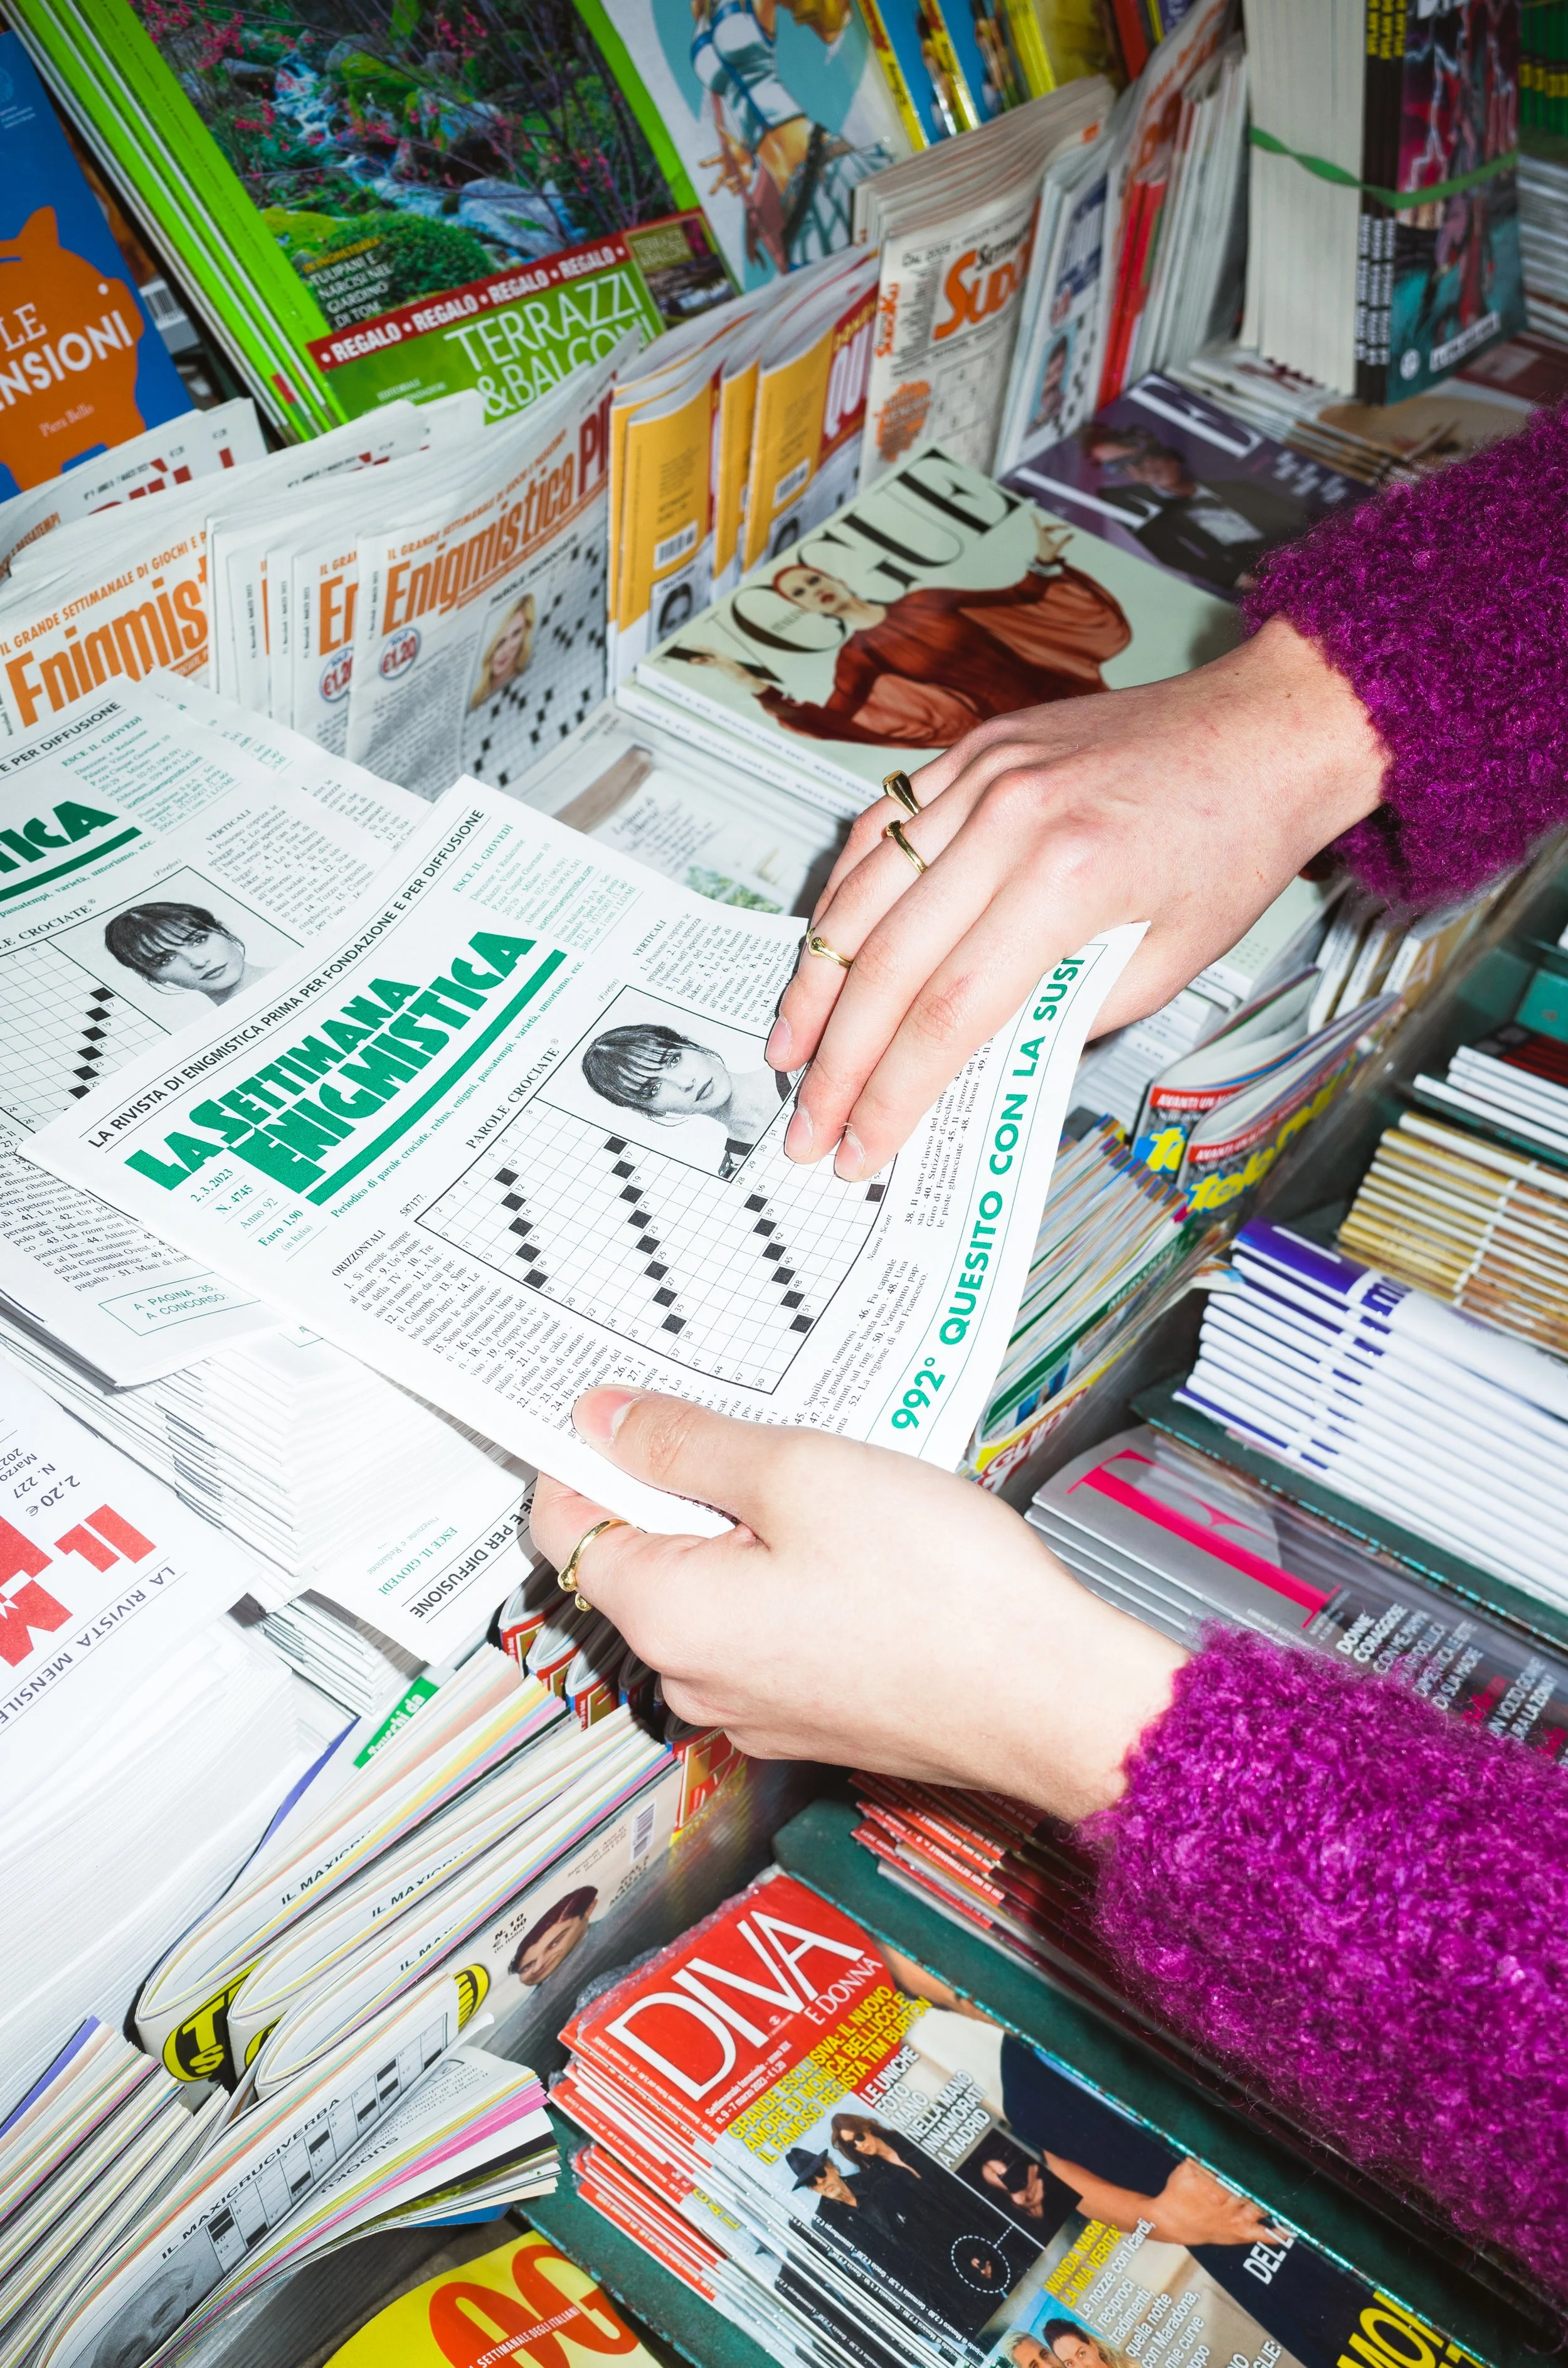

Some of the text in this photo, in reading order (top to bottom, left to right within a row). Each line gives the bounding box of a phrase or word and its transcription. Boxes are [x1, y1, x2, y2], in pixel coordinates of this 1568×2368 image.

[330, 322, 402, 363] REGALO
[411, 295, 479, 332] REGALO
[487, 268, 549, 304] REGALO
[558, 247, 617, 279] REGALO
[444, 271, 644, 371] TERRAZZI
[0, 309, 134, 411] NSIONI
[382, 452, 575, 637] Enigmistica
[662, 447, 1021, 684] VOGUE
[14, 541, 189, 649] GRANDE SETTIMANALE DI GIOCHI
[10, 701, 121, 767] PER DIFFUSIONE
[205, 809, 252, 841] VERTICALI
[91, 851, 139, 877] umorismo,
[452, 823, 513, 893] ESCE IL GIOVEDÌ
[18, 905, 92, 940] CROCIATE
[633, 920, 667, 958] VERTICALI
[646, 940, 669, 965] Possono
[729, 933, 753, 963] Ricamare
[88, 809, 485, 1148] LA RIVISTA DI ENIGMISTICA PRIMA PER FONDAZIONE E PER DIFFUSIONE
[597, 978, 620, 1002] (Firefox)
[189, 978, 421, 1146] SETTIMANA
[226, 932, 538, 1194] ENIGMISTICA
[331, 961, 585, 1218] Periodico di parole crociate, rebus, enigmi, passatempi, varietà, umorismo, ecc.
[465, 1047, 559, 1149] PAROLE CROCIATE
[124, 1131, 225, 1191] LA
[929, 1140, 943, 1180] Strizzate
[936, 1154, 951, 1189] Francia
[948, 1142, 964, 1190] ghiacciate
[191, 1169, 233, 1203] 2.3.2023
[215, 1184, 253, 1214] N. 4745
[891, 959, 1086, 1431] 992° QUESITO CON LA SUSI
[3, 1220, 48, 1240] personale
[240, 1197, 278, 1229] Anno 92
[257, 1209, 304, 1247] Euro 1,90
[33, 1241, 78, 1261] pasticcini
[78, 1250, 122, 1268] Germania
[332, 1229, 386, 1277] ORIZZONTALI
[365, 1231, 411, 1273] prende sempre
[867, 1214, 893, 1261] Naomi Scott
[92, 1256, 142, 1273] conduttrice
[148, 1289, 196, 1305] PAGINA
[159, 1293, 229, 1315] CONCORSO:
[404, 1298, 435, 1324] Colombo
[463, 1286, 487, 1310] scimmie
[834, 1258, 897, 1366] rumorosi capitale
[882, 1284, 909, 1329] Variopinto
[901, 1272, 929, 1316] Francesco.
[549, 1331, 568, 1354] calcio
[829, 1353, 857, 1396] gondoliere
[13, 1475, 38, 1499] 227
[40, 1474, 81, 1507] 2,20
[149, 1566, 176, 1586] LA
[378, 1526, 458, 1596] ESCE GIOVEDÌ
[410, 1549, 489, 1618] DIFFUSIONE
[77, 1590, 147, 1648] RIVISTA
[405, 1692, 426, 1714] da
[510, 1914, 524, 1928] 10
[605, 1910, 865, 2102] DIVA
[804, 1957, 883, 2026] E DONNA
[726, 2084, 783, 2138] GRANDE
[776, 2031, 846, 2093] ESCLUSIVA:
[848, 1985, 893, 2026] NUOVO
[743, 2002, 901, 2153] AMORE MONICA BELLUCCI
[773, 1995, 933, 2155] FAMOSO REGISTA TIM BURTON
[860, 2045, 920, 2105] LE UNICHE
[876, 2081, 911, 2114] FOTO
[911, 2069, 975, 2142] NELLA MANO
[921, 2082, 988, 2154] INNAMORATI
[946, 2108, 991, 2158] MADRID
[183, 2098, 341, 2239] MAXICRUCIVERBA
[1042, 2219, 1108, 2295] WANDA NARA
[1072, 2266, 1096, 2296] MIA
[1089, 2217, 1157, 2302] nozze Icardi,
[1242, 2240, 1287, 2285] DEL
[1097, 2276, 1136, 2328] reciproci
[1108, 2286, 1157, 2345] tradimenti,
[1125, 2292, 1173, 2358] quella notte
[1152, 2290, 1201, 2350] Maradona,
[477, 2306, 582, 2368] SETTIMANALE DEGLI ITALIANI
